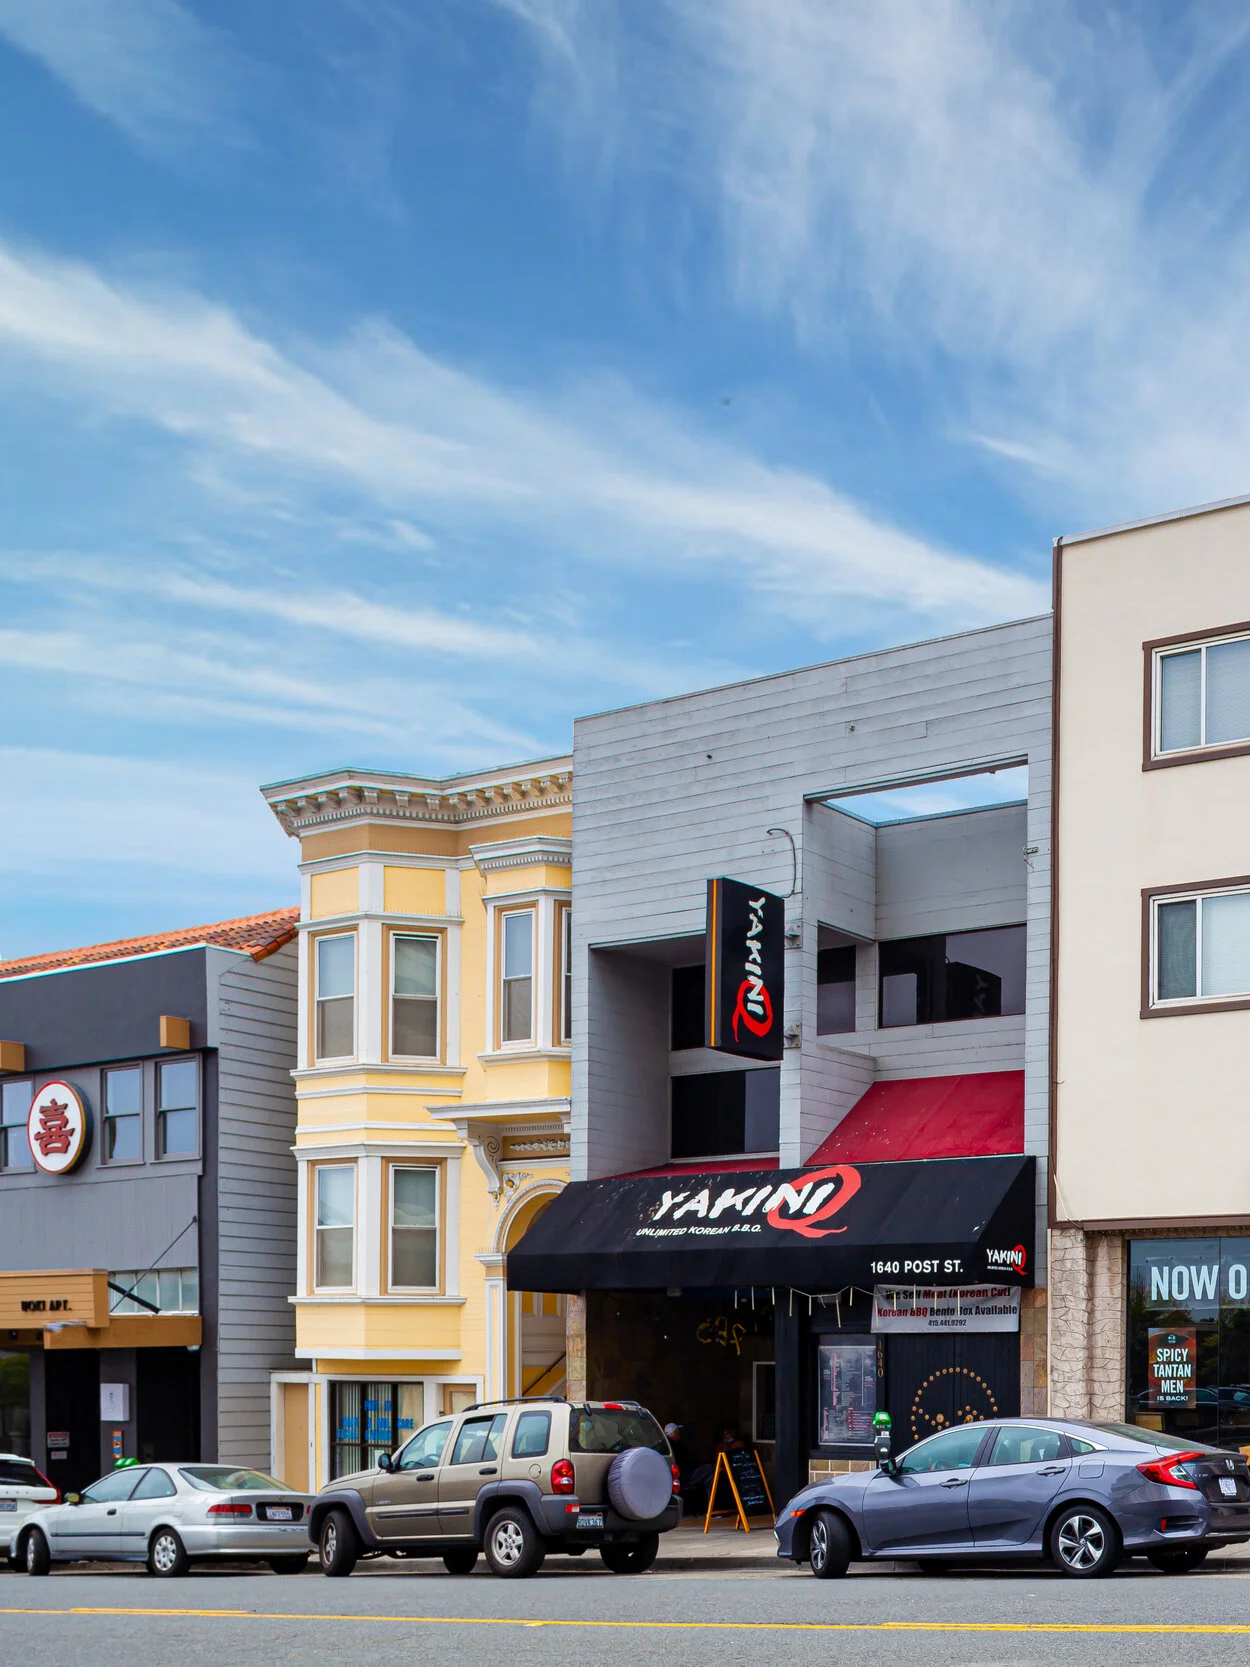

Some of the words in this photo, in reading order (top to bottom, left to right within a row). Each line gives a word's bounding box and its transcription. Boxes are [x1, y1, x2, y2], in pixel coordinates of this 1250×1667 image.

[745, 897, 766, 1015] YAKINI
[34, 1098, 75, 1156] 喜
[653, 1182, 835, 1220] YAKINI
[636, 1226, 688, 1237] UNLIMITED
[688, 1225, 731, 1235] KOREAN
[986, 1248, 1022, 1266] YAKINI
[870, 1261, 899, 1273] 1640
[904, 1260, 939, 1273] POST
[944, 1260, 963, 1273] ST.
[1151, 1265, 1219, 1300] NOW
[877, 1307, 908, 1317] Korean
[975, 1305, 1018, 1315] Available
[927, 1319, 967, 1327] 415.441.9292
[1156, 1348, 1188, 1362] SPICY
[1153, 1364, 1191, 1377] TANTAN
[1161, 1380, 1184, 1393] MEN
